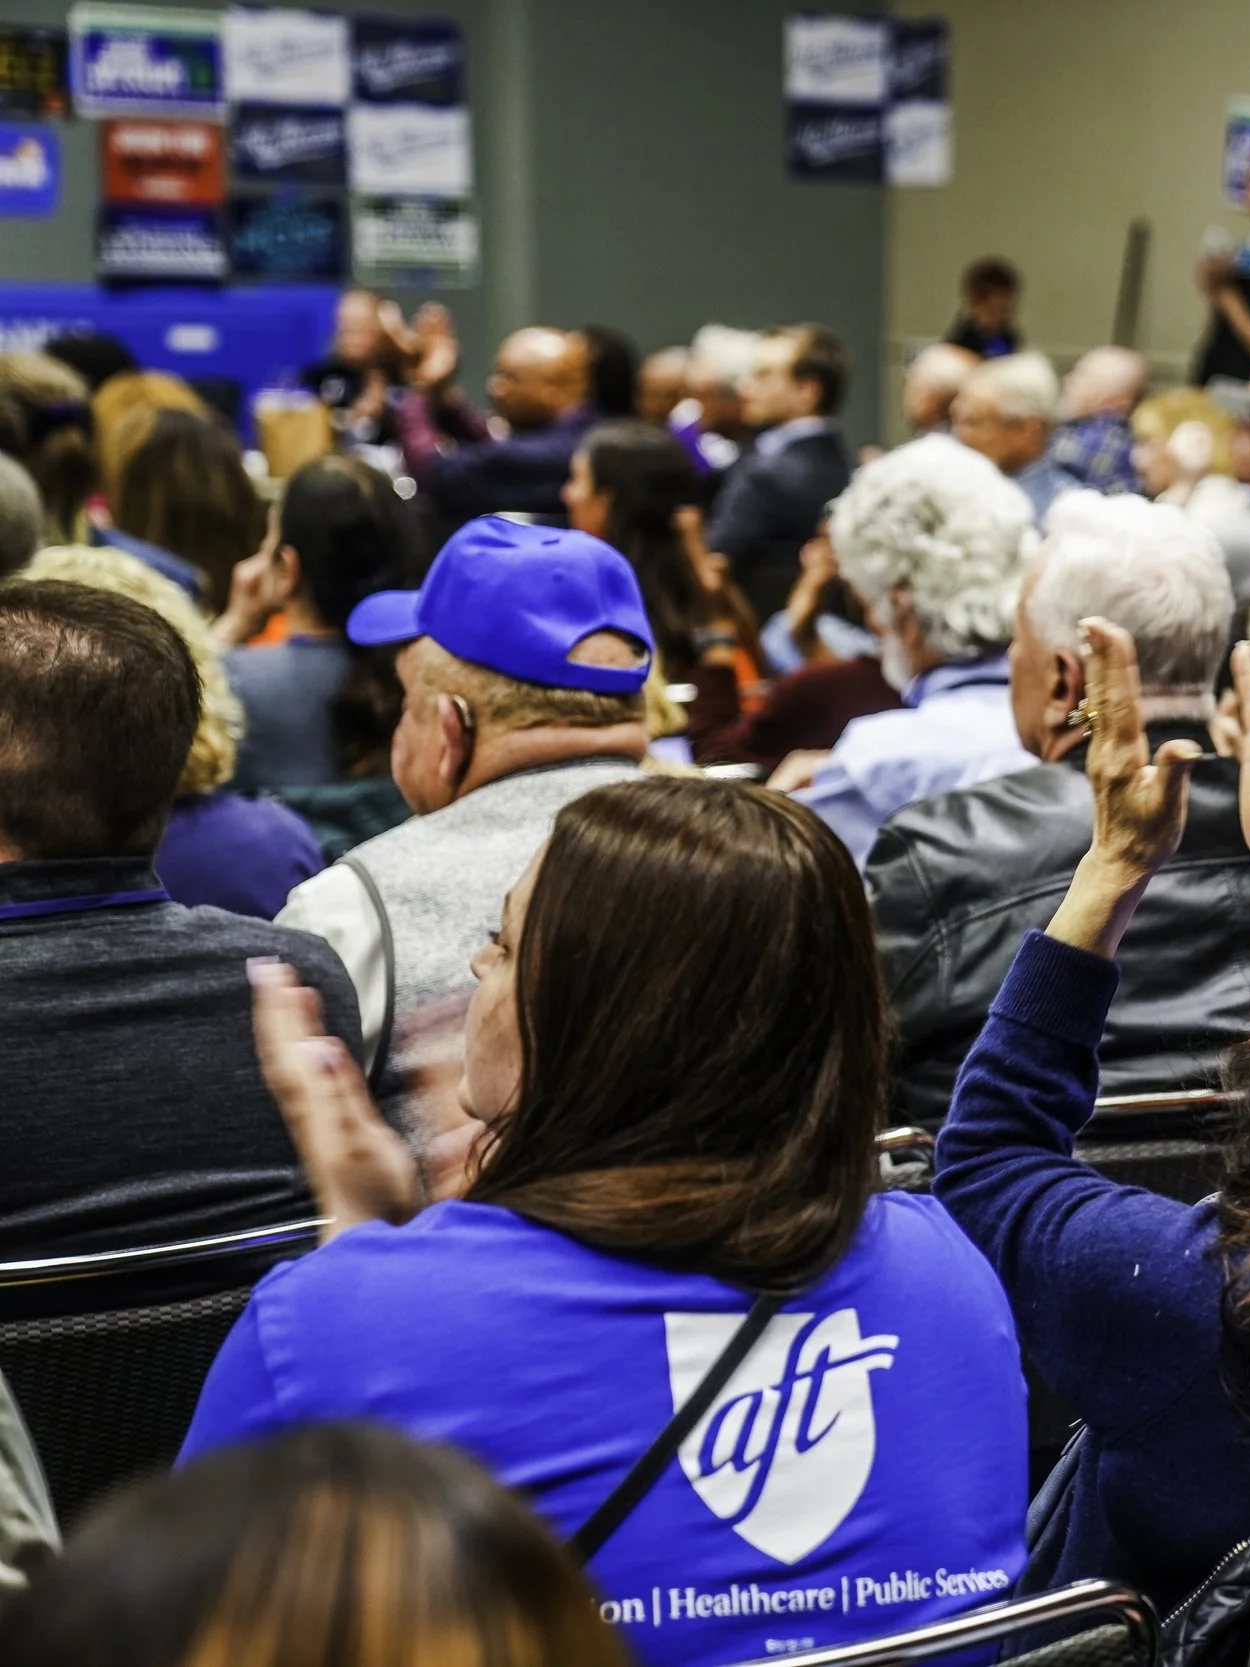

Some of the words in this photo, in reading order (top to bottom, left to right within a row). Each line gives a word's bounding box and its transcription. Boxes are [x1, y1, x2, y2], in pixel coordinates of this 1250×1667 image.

[697, 1309, 898, 1526] aft
[668, 1584, 833, 1620] Healthcare
[855, 1569, 932, 1608] Public
[935, 1567, 1010, 1596] Services
